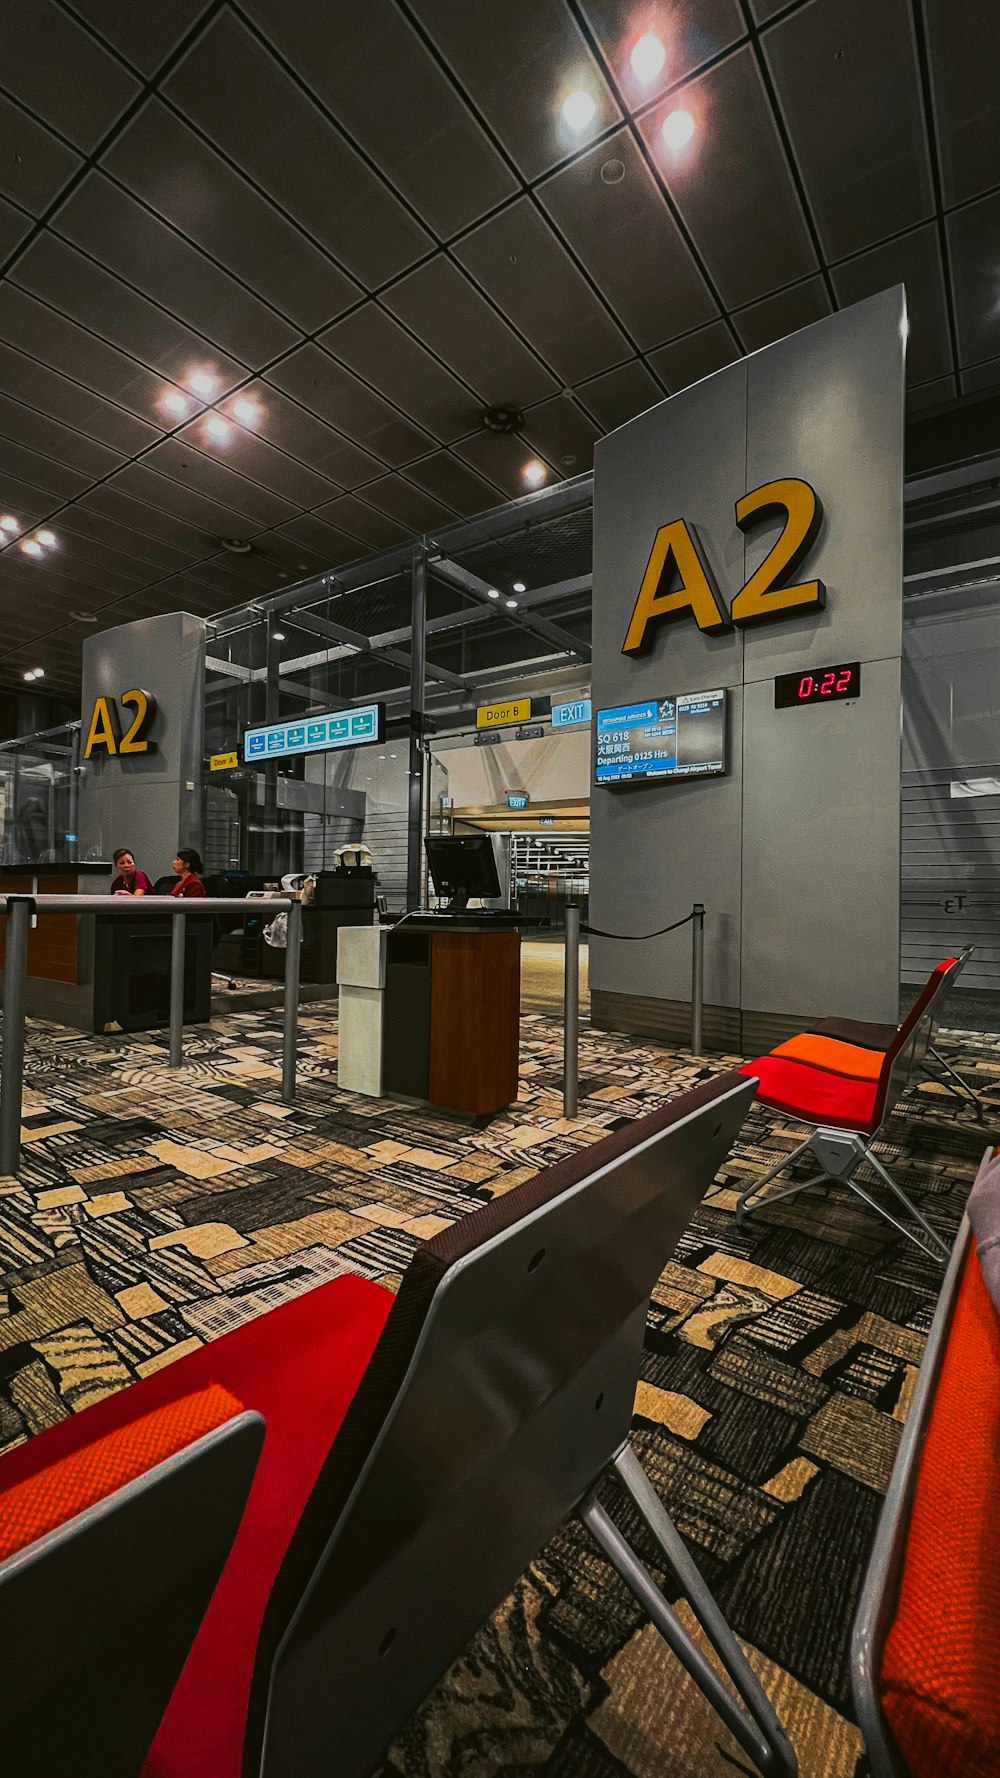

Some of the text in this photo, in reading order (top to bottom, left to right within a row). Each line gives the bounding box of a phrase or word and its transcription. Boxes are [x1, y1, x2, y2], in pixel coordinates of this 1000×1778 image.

[621, 477, 824, 656] A2
[798, 669, 852, 698] 0:22
[486, 706, 519, 721] Door B
[560, 703, 584, 722] EXIT
[83, 688, 152, 759] A2
[597, 731, 630, 745] SQ 618
[213, 758, 228, 767] Door
[597, 749, 668, 766] Departing 0125 Hrs
[509, 798, 522, 807] EXIT
